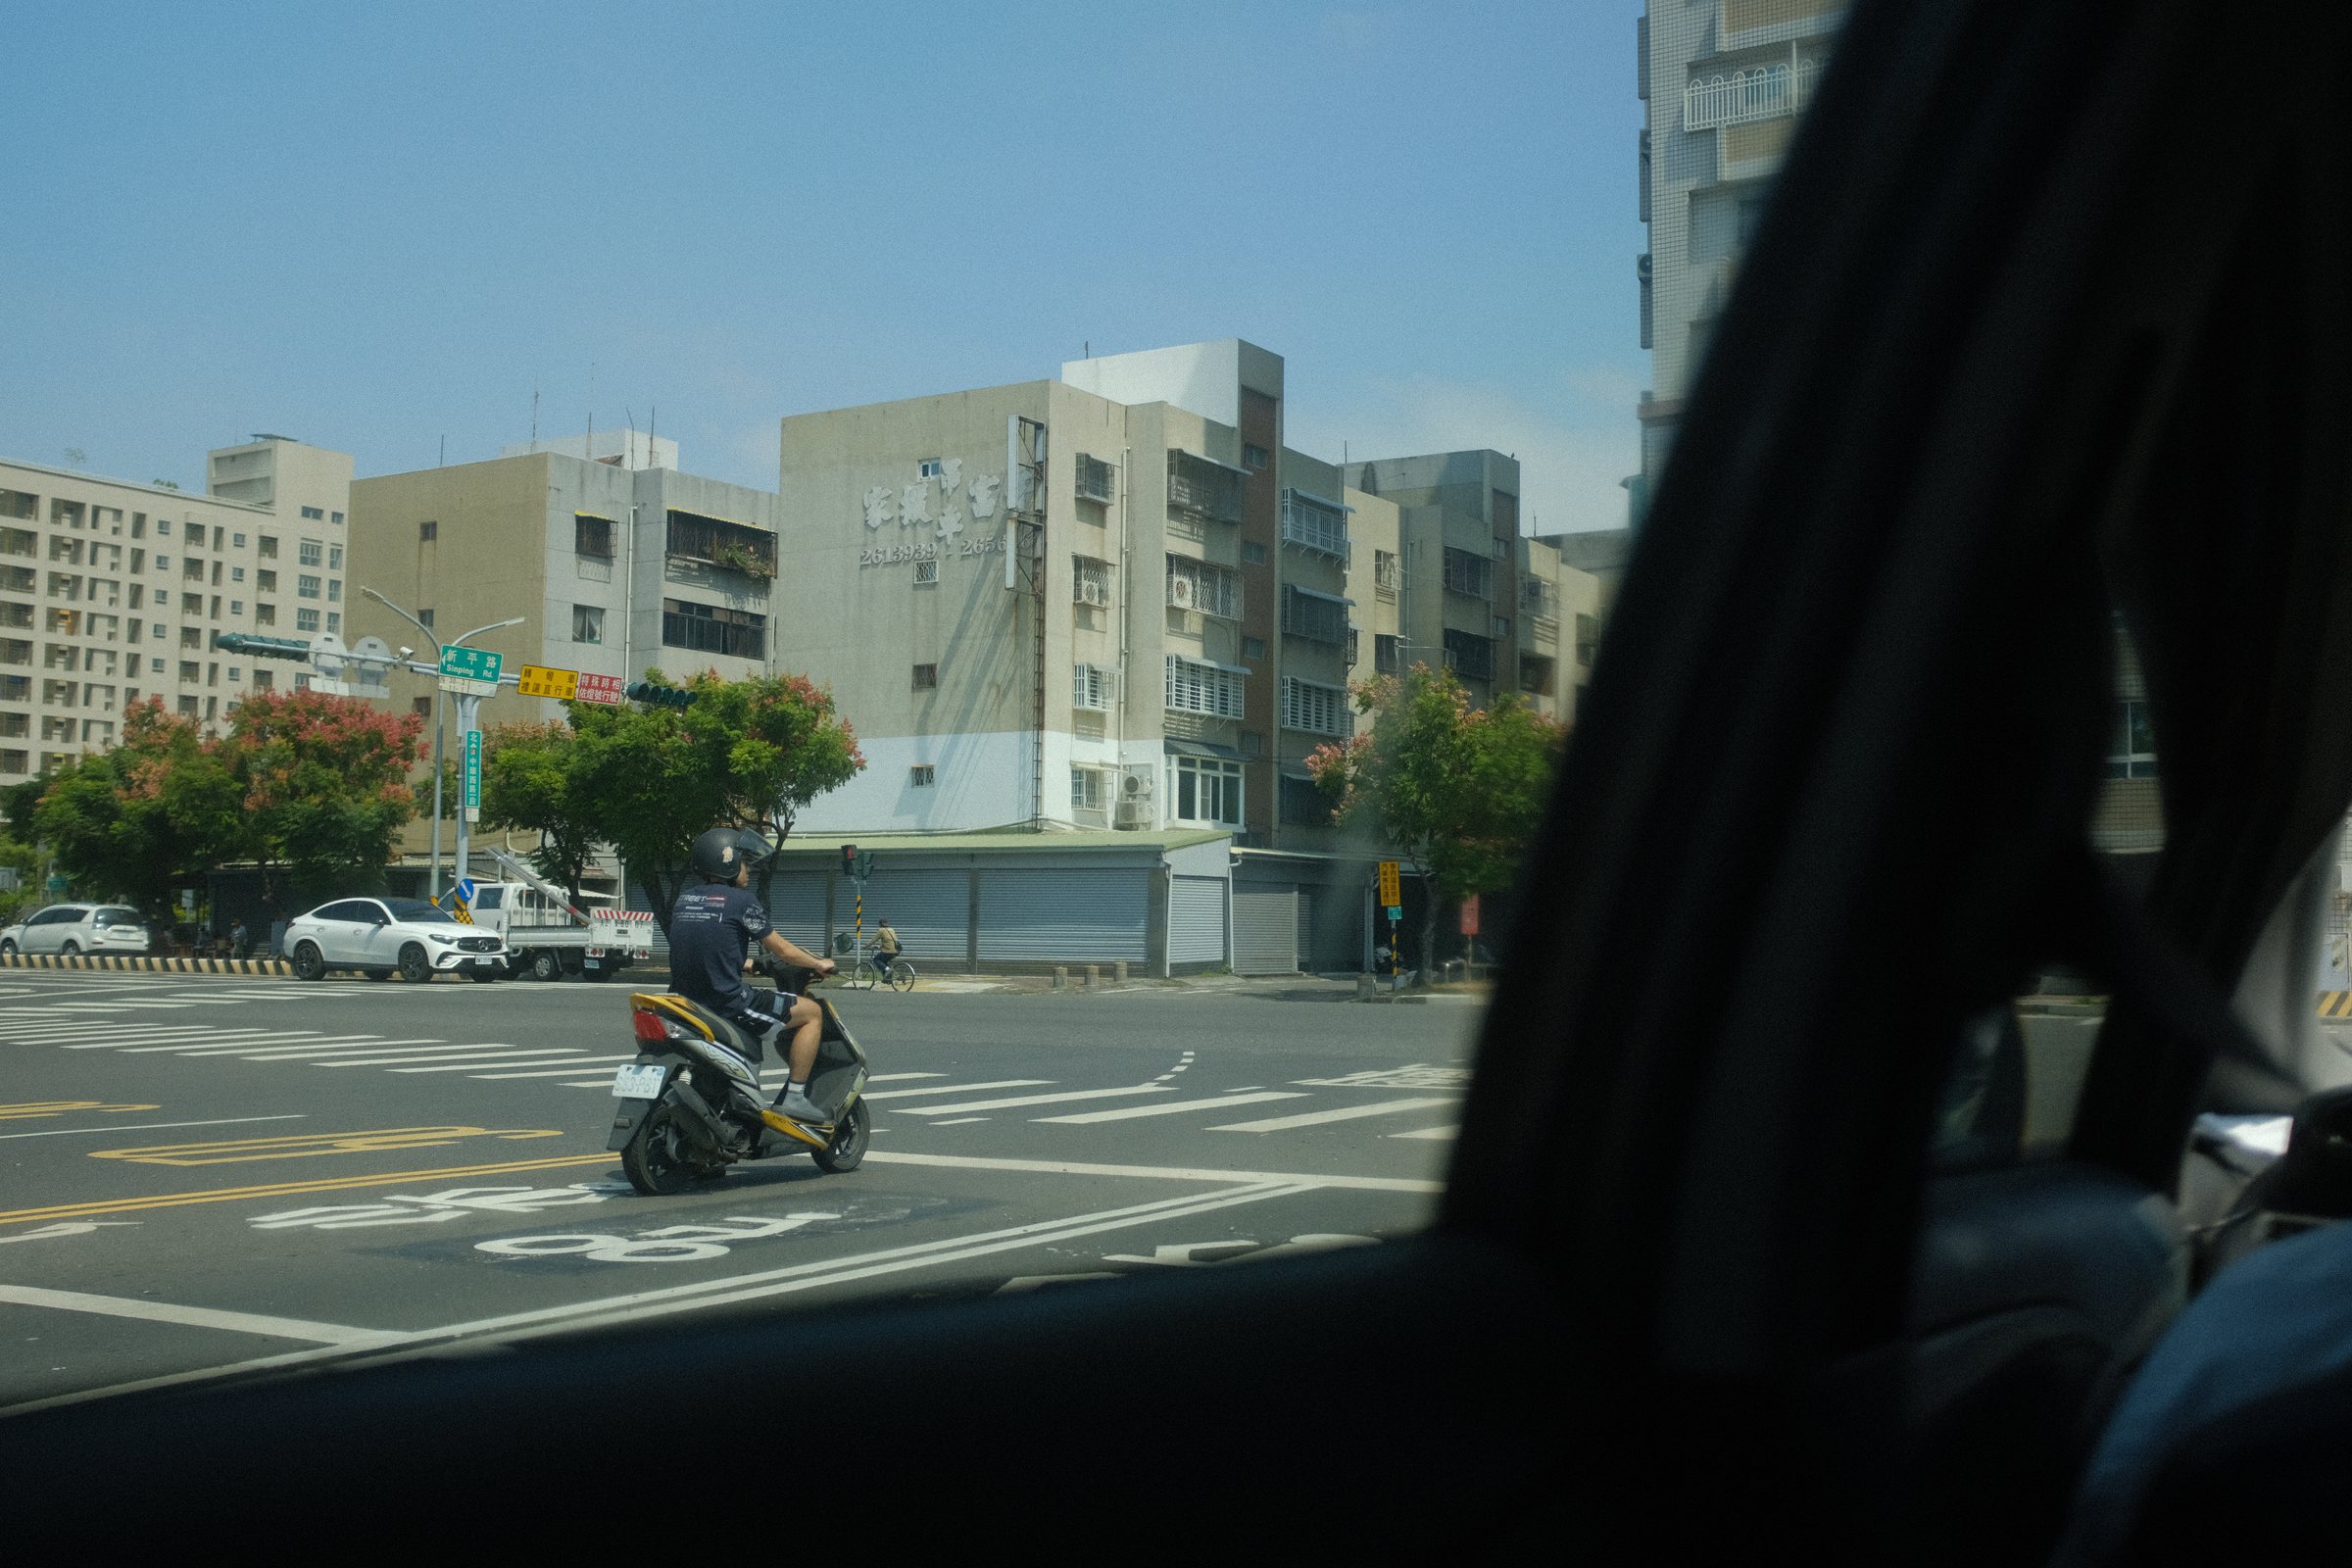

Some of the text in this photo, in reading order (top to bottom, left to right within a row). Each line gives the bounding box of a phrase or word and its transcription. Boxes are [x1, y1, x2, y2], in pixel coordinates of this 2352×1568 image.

[860, 542, 938, 565] 2613939
[446, 649, 497, 668] 新平路
[446, 664, 474, 677] Sinping
[581, 675, 621, 690] 特殊時相
